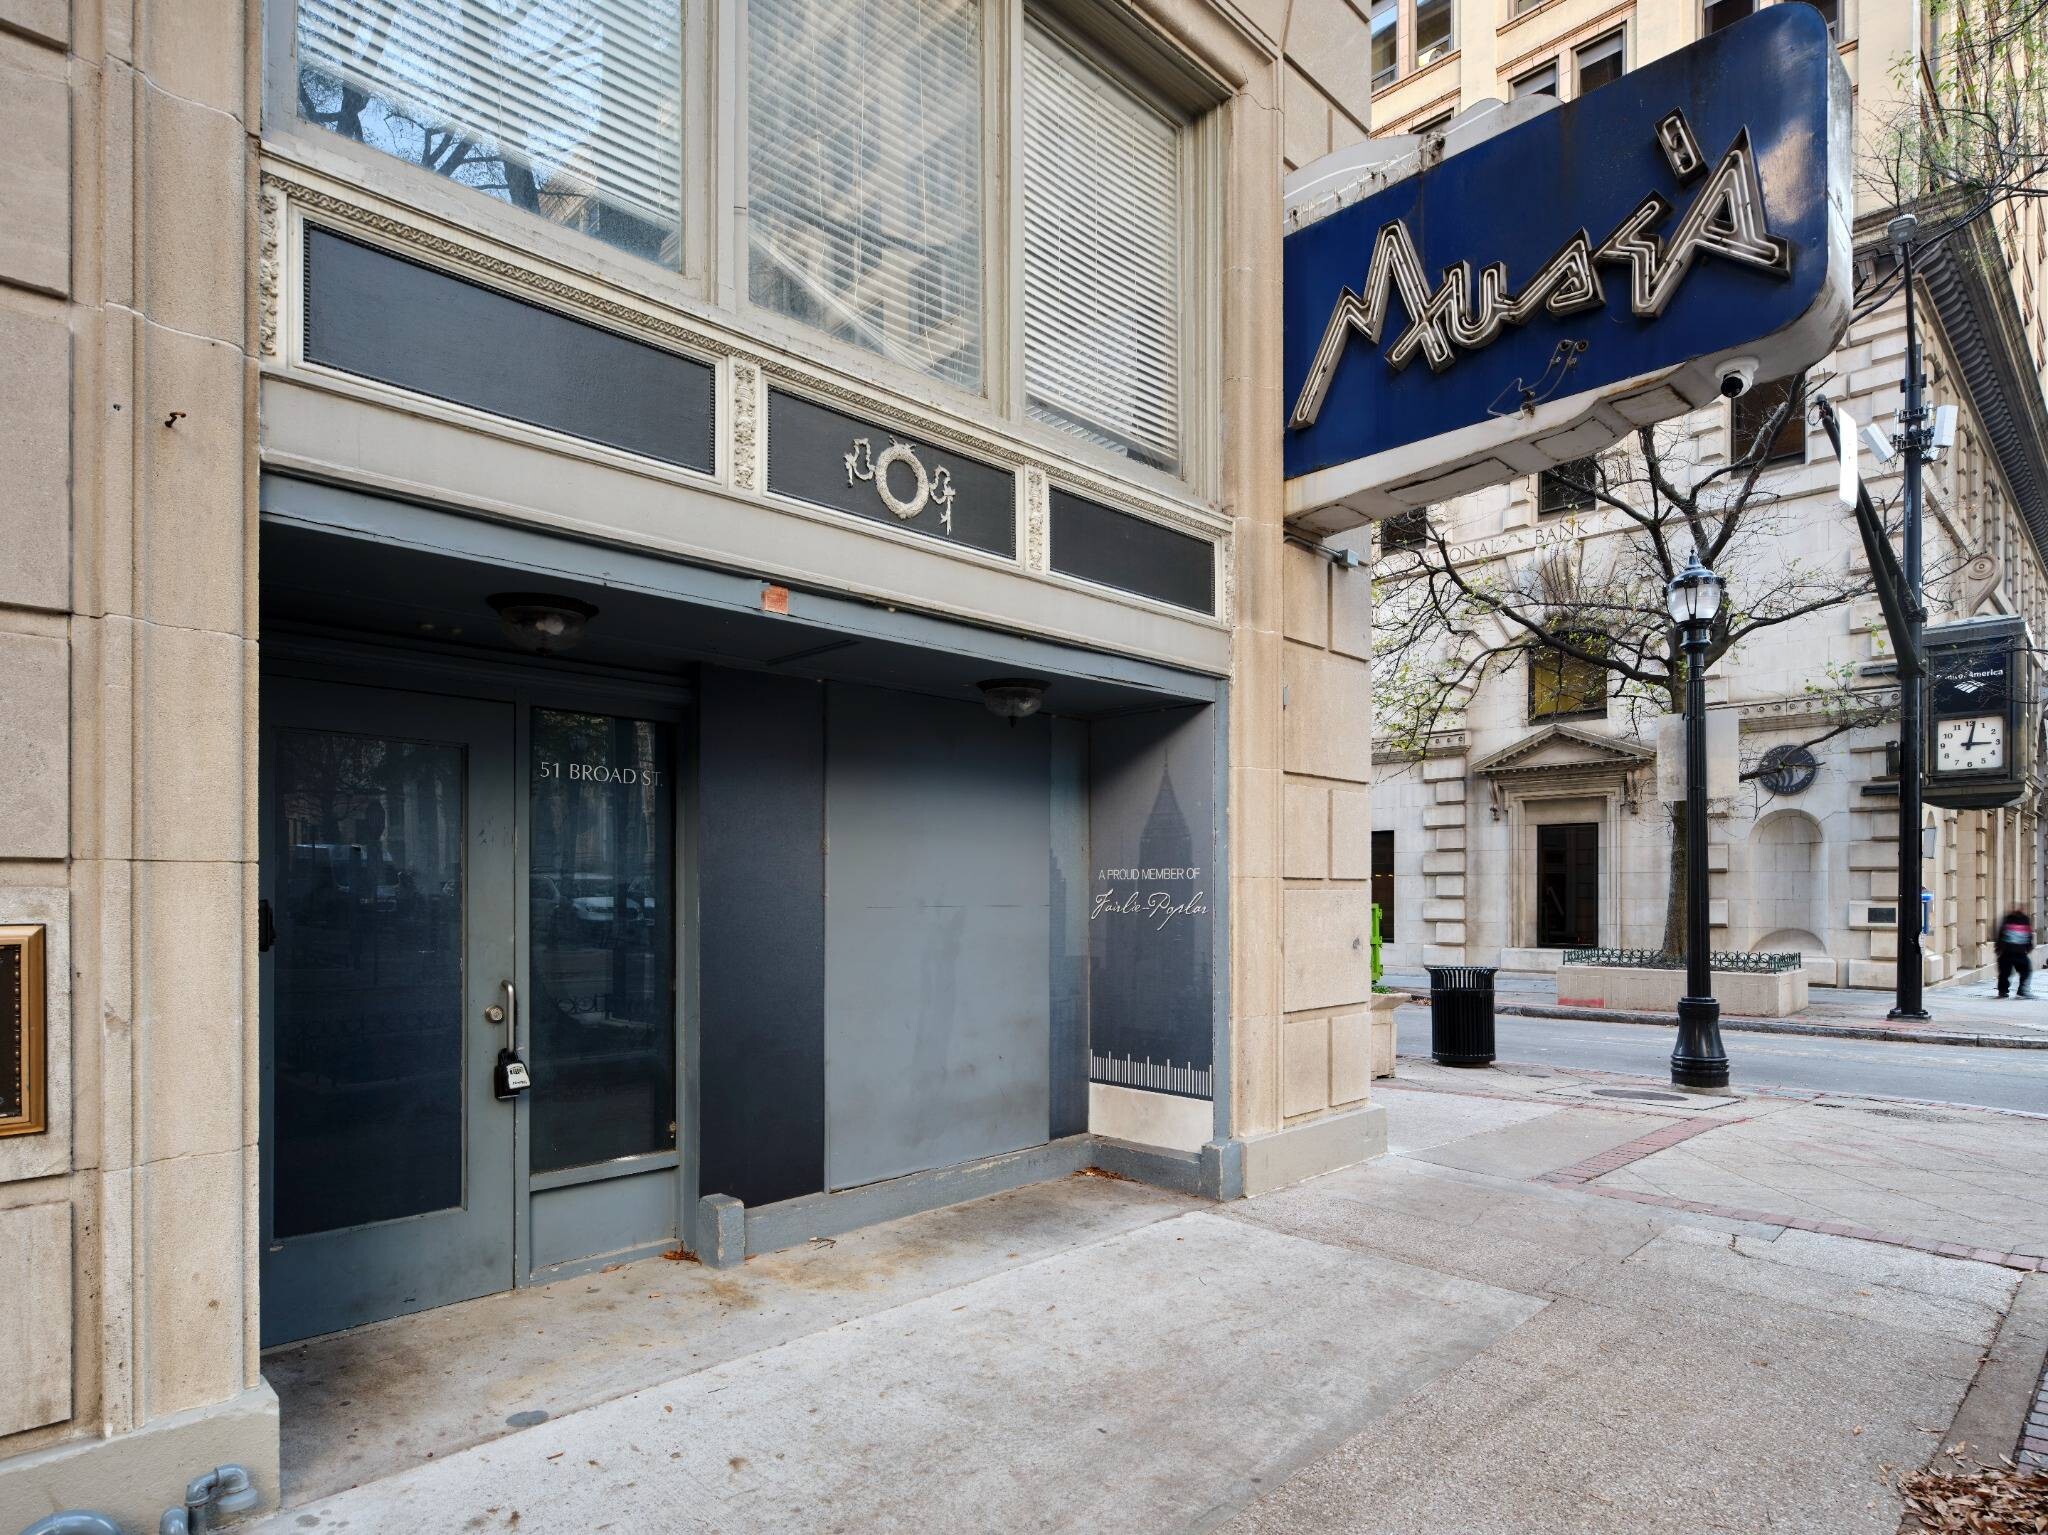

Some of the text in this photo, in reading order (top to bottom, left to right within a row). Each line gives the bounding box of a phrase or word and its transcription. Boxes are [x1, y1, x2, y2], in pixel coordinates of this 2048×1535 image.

[1535, 519, 1588, 544] BANK
[1968, 668, 2004, 678] America
[540, 761, 559, 778] 51
[569, 763, 637, 784] BROAD
[1098, 867, 1201, 880] A PROUD MEMBER OF
[1091, 888, 1209, 931] Fairlie-Poplar
